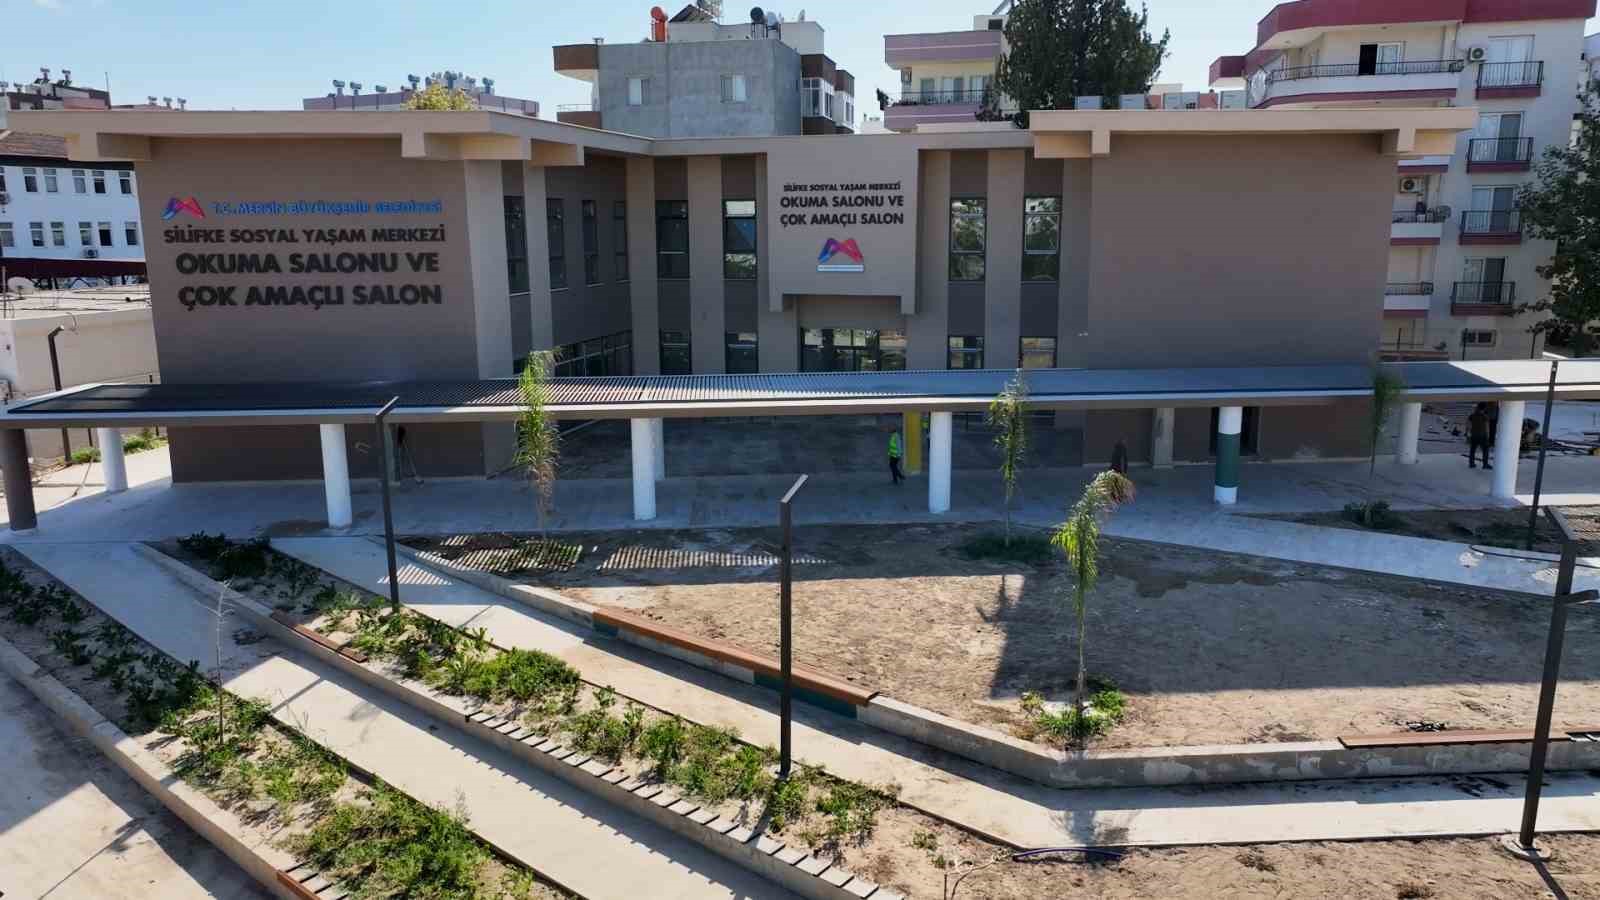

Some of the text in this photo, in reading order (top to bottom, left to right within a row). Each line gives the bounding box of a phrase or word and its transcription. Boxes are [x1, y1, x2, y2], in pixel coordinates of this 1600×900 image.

[780, 195, 904, 208] OKUMA SALONU VE
[780, 212, 904, 228] ÇOK AMAÇLI SALON
[163, 224, 446, 246] SİLİFKE SOSYAL YAŞAM MERKEZİ
[175, 252, 440, 274] OKUMA SALONU VE
[178, 284, 443, 311] ÇOK AMAÇLI SALON
